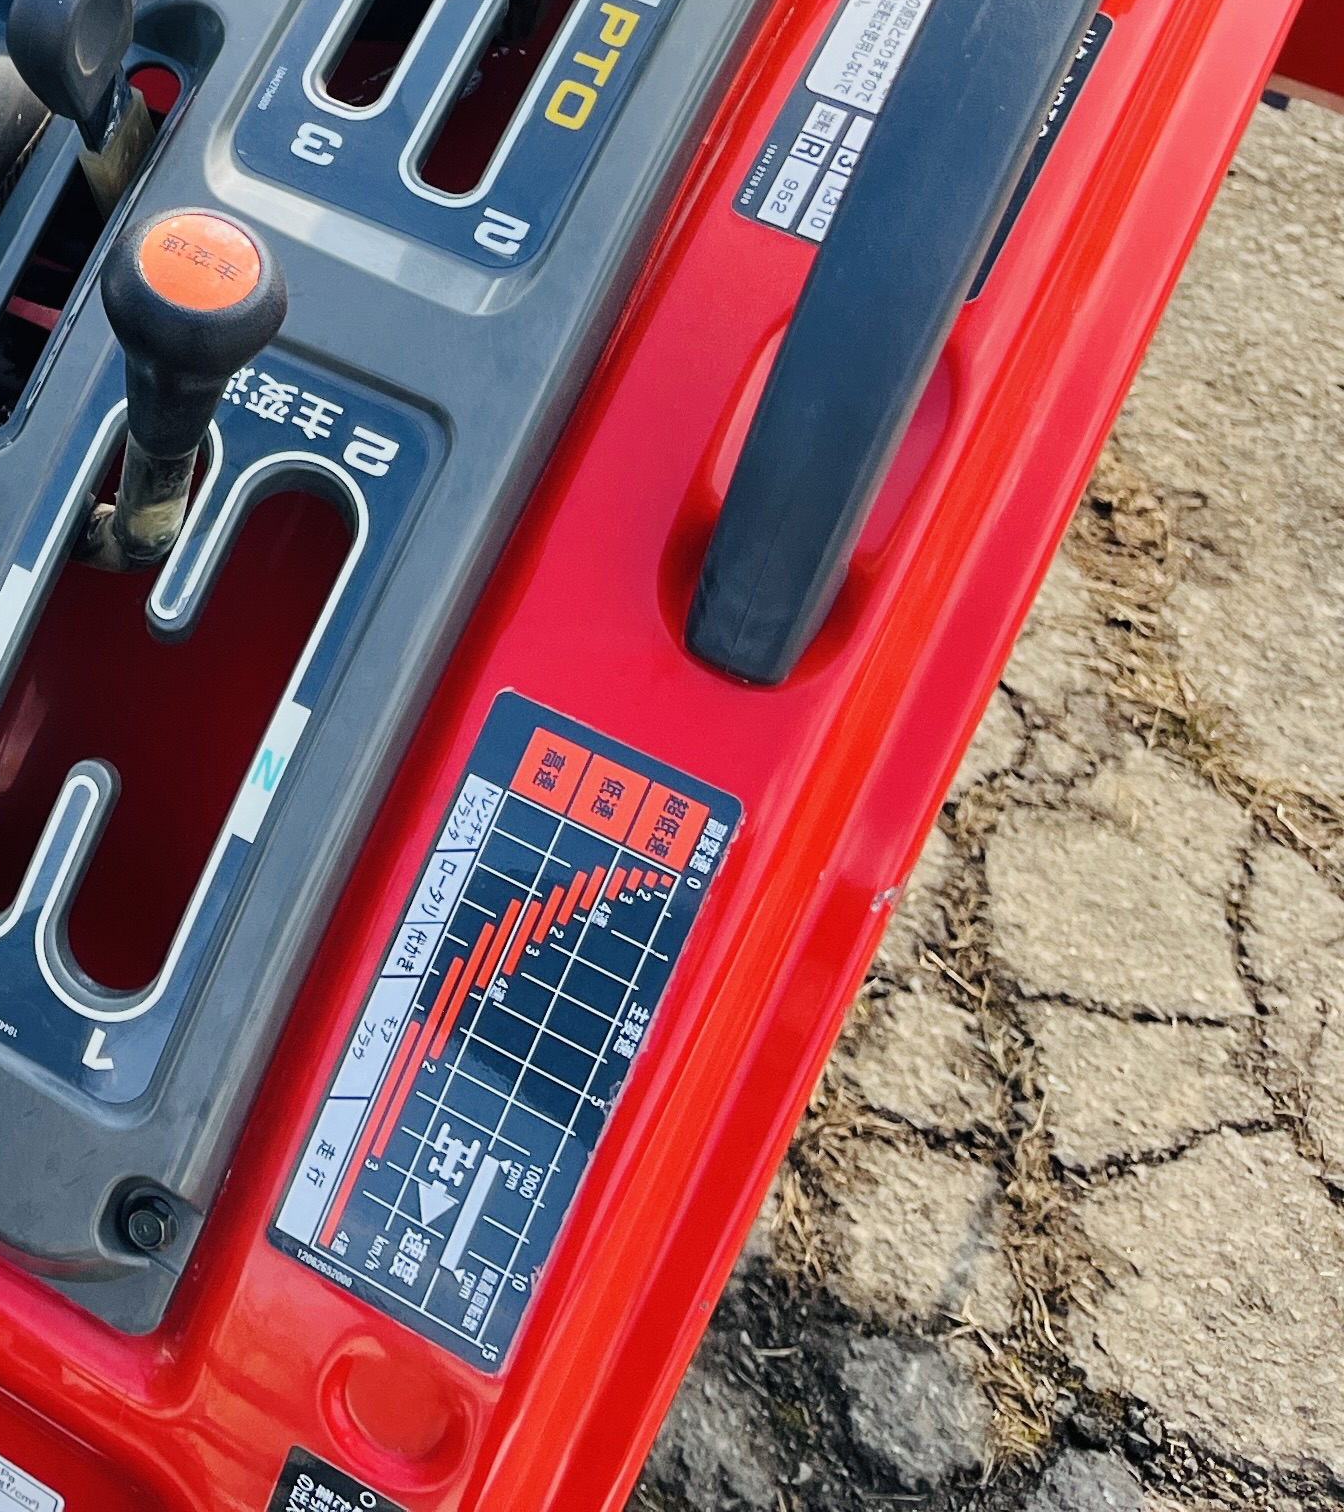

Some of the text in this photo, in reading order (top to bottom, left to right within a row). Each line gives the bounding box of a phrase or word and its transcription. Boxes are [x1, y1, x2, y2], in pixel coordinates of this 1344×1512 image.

[544, 3, 640, 131] PTO
[290, 122, 342, 165] 3
[797, 136, 825, 161] R
[770, 178, 800, 216] 952
[474, 208, 532, 256] 2
[159, 233, 243, 282] 主変速
[343, 426, 400, 477] 2
[253, 750, 286, 792] N
[533, 747, 567, 793] 高速
[466, 787, 500, 846] トレンチャ
[591, 777, 626, 821] 低速
[645, 794, 690, 860] 超低速
[421, 860, 457, 919] ロータリ
[619, 892, 634, 905] 3
[636, 888, 652, 902] 2
[397, 927, 428, 972] 代かき
[525, 944, 540, 957] 3
[549, 925, 565, 940] 2
[379, 1014, 399, 1045] モア
[613, 1002, 651, 1059] 主変速
[81, 1030, 114, 1073] 1
[421, 1060, 437, 1074] 2
[590, 1095, 605, 1108] 5
[307, 1139, 336, 1189] 走行
[364, 1158, 379, 1172] 3
[505, 1162, 521, 1191] rpm
[520, 1164, 543, 1200] 1000
[364, 1234, 389, 1270] km/h
[389, 1227, 431, 1287] 速度
[459, 1272, 476, 1300] rpm
[511, 1272, 528, 1293] 10
[481, 1342, 500, 1363] 15
